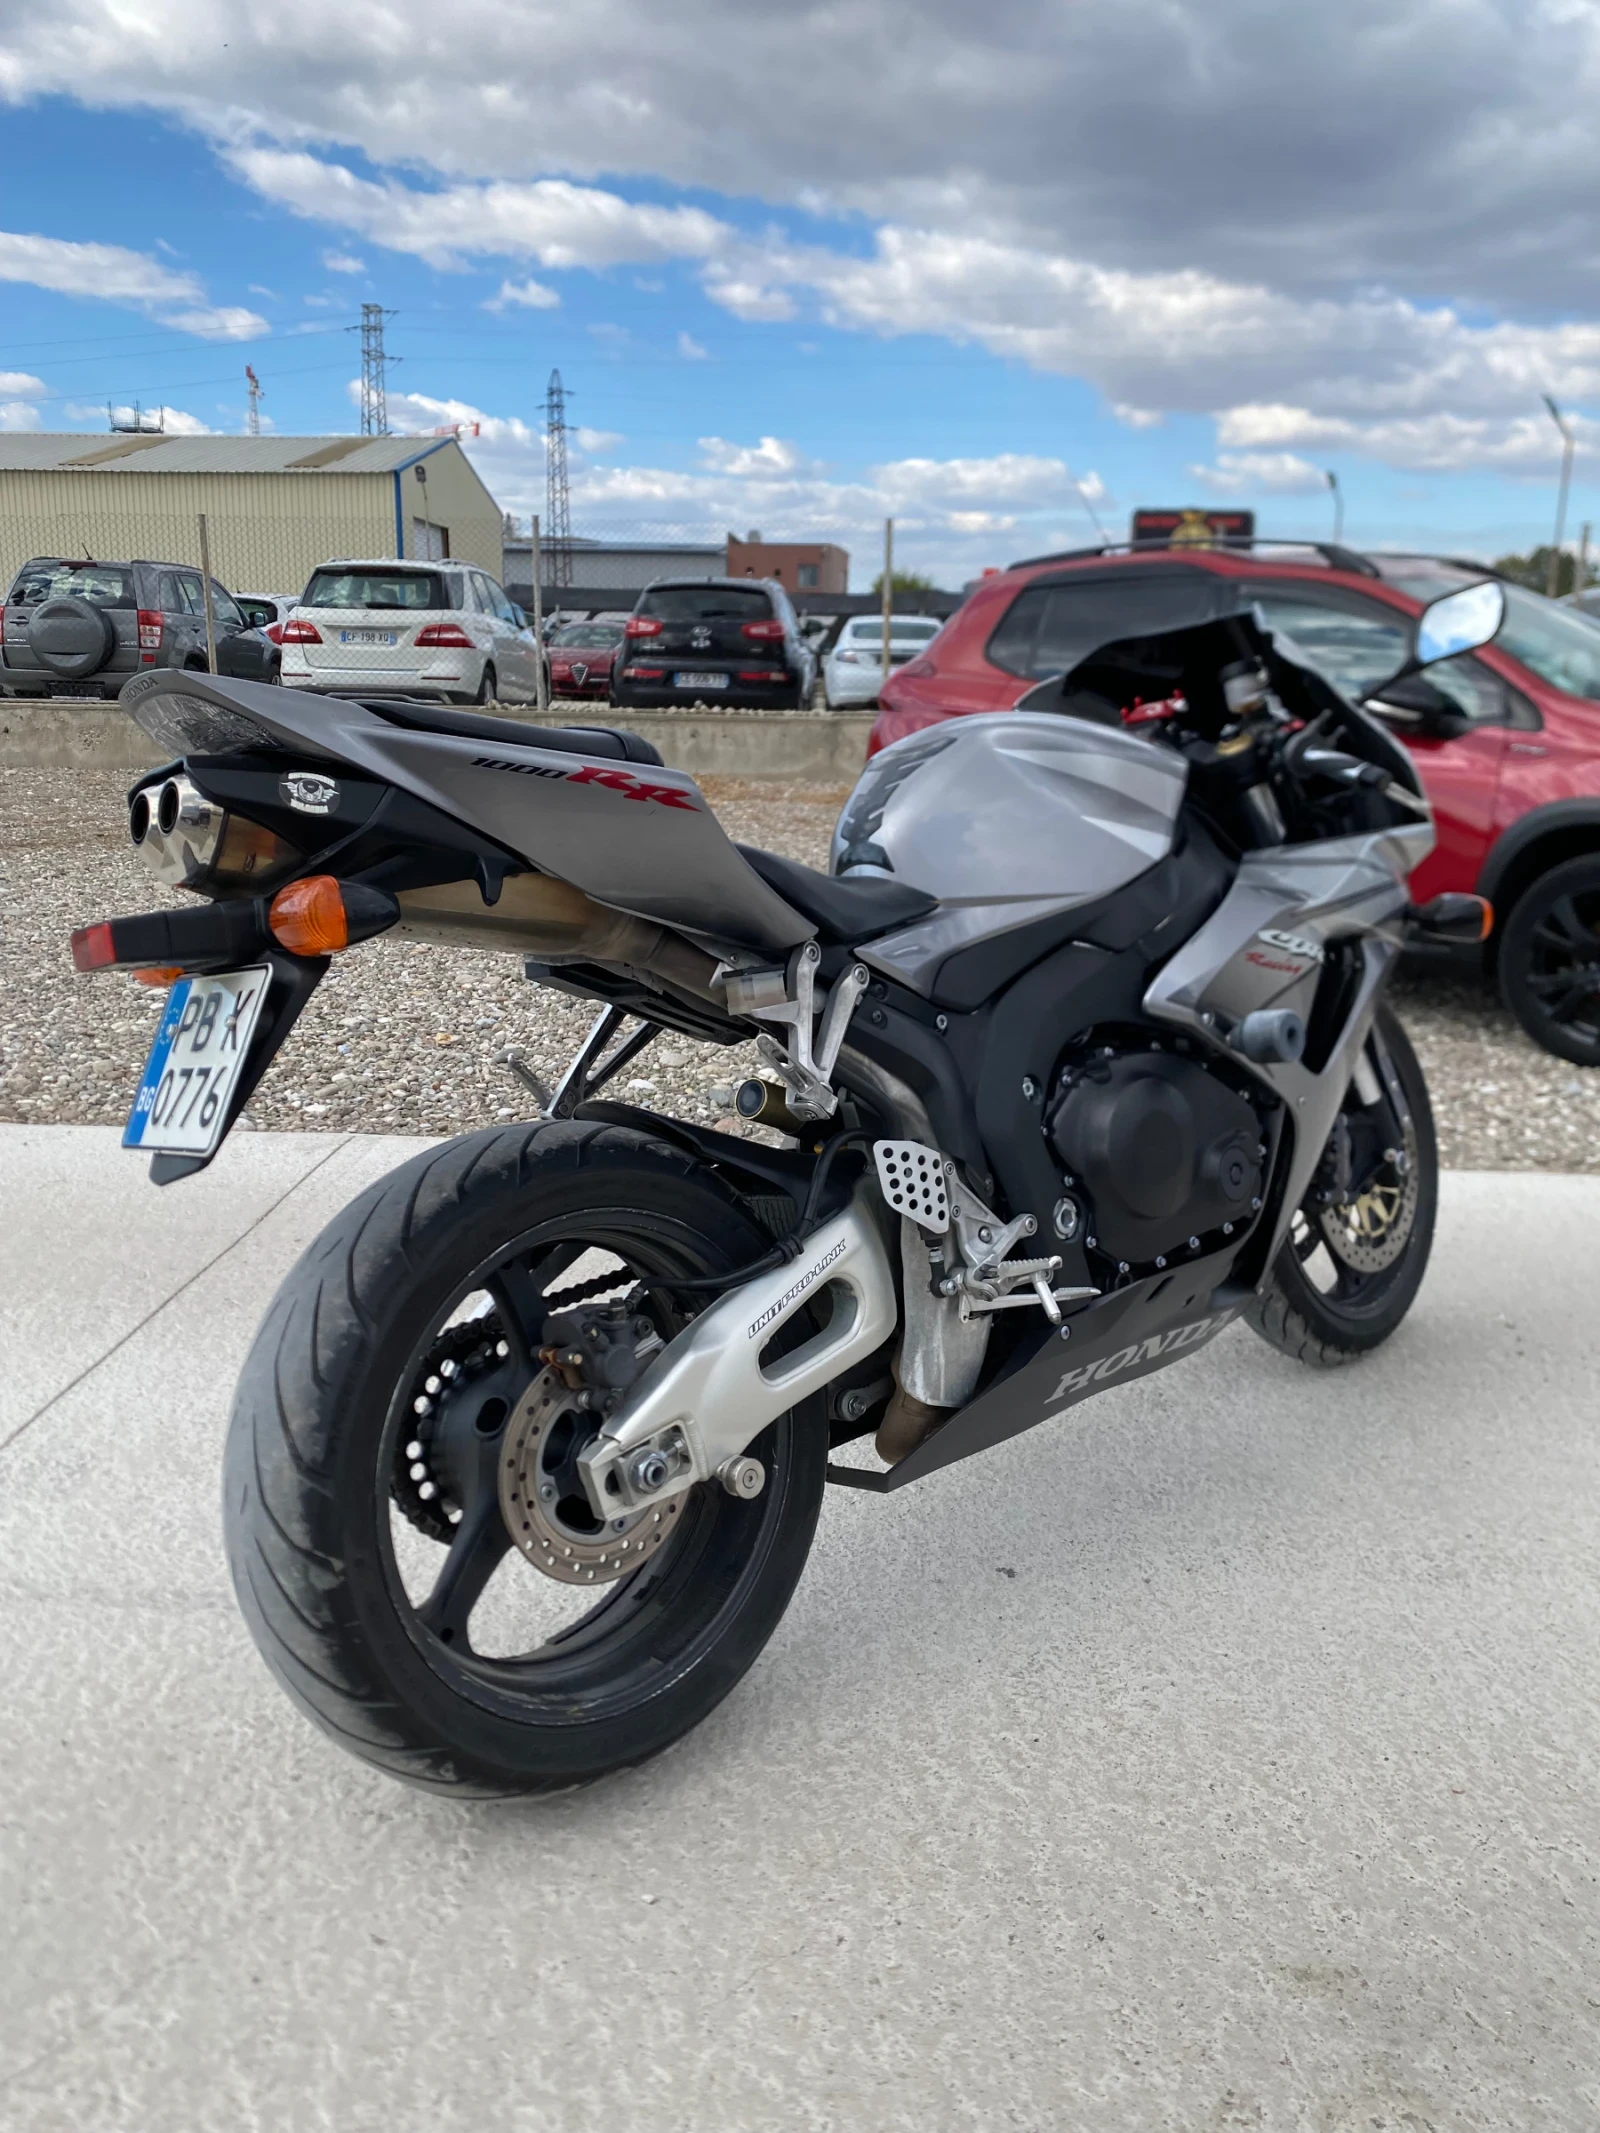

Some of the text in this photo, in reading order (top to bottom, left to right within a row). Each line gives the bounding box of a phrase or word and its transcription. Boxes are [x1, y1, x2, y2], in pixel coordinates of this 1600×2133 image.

[123, 676, 159, 703] HONDA
[172, 991, 224, 1053] PB
[136, 1086, 157, 1112] BG
[151, 1066, 228, 1128] 0776
[748, 1238, 847, 1339] UNIT PRO-LINK
[1043, 1308, 1235, 1404] HONDA
